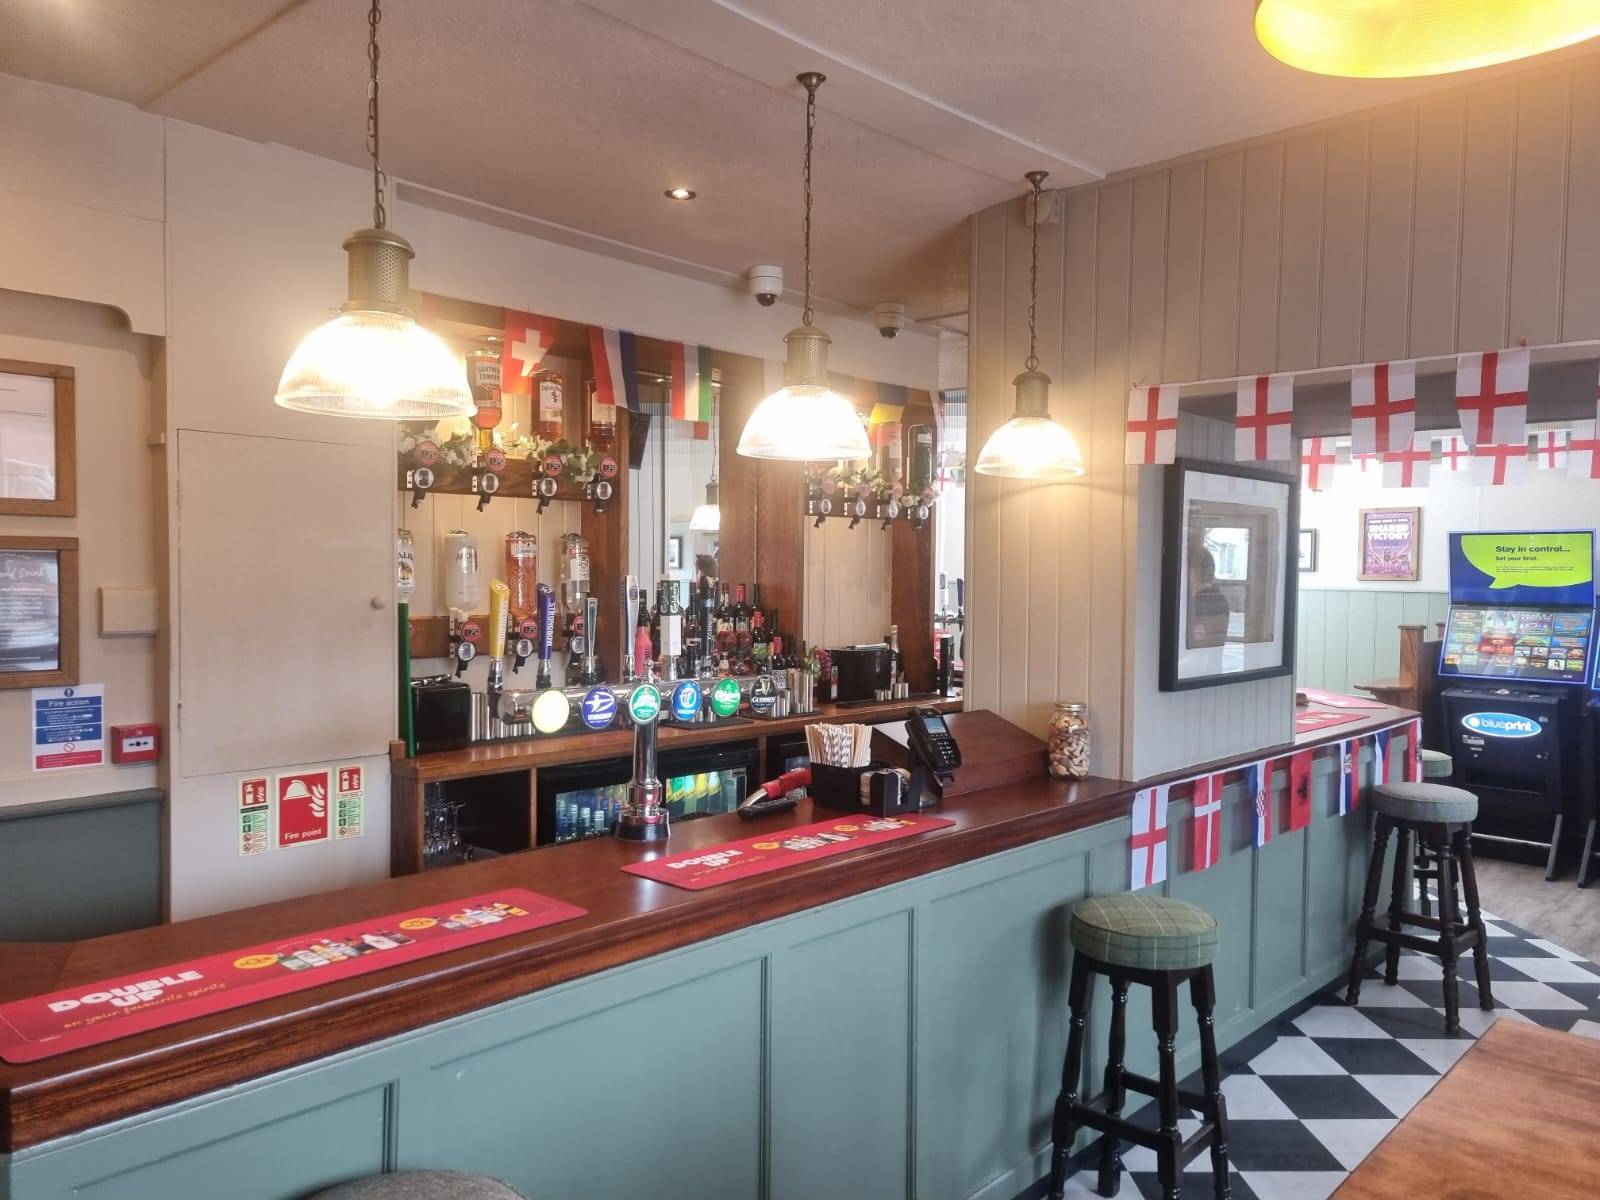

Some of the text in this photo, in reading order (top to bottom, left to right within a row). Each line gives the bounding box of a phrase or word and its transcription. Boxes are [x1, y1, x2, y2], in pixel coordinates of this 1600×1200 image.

[1367, 532, 1410, 541] VICTORY
[1495, 545, 1516, 553] Stay
[1528, 545, 1571, 553] control...
[19, 567, 44, 577] Drink
[670, 582, 680, 614] Carlsberg
[546, 601, 556, 647] STRONGBOW
[1481, 718, 1532, 731] blueprint
[284, 828, 322, 840] Fire point
[666, 850, 743, 869] DOUBLE
[48, 970, 204, 1013] DOUBLE
[110, 989, 164, 1007] UP
[86, 1010, 121, 1025] your
[124, 994, 184, 1014] favourite
[187, 982, 226, 997] spirits
